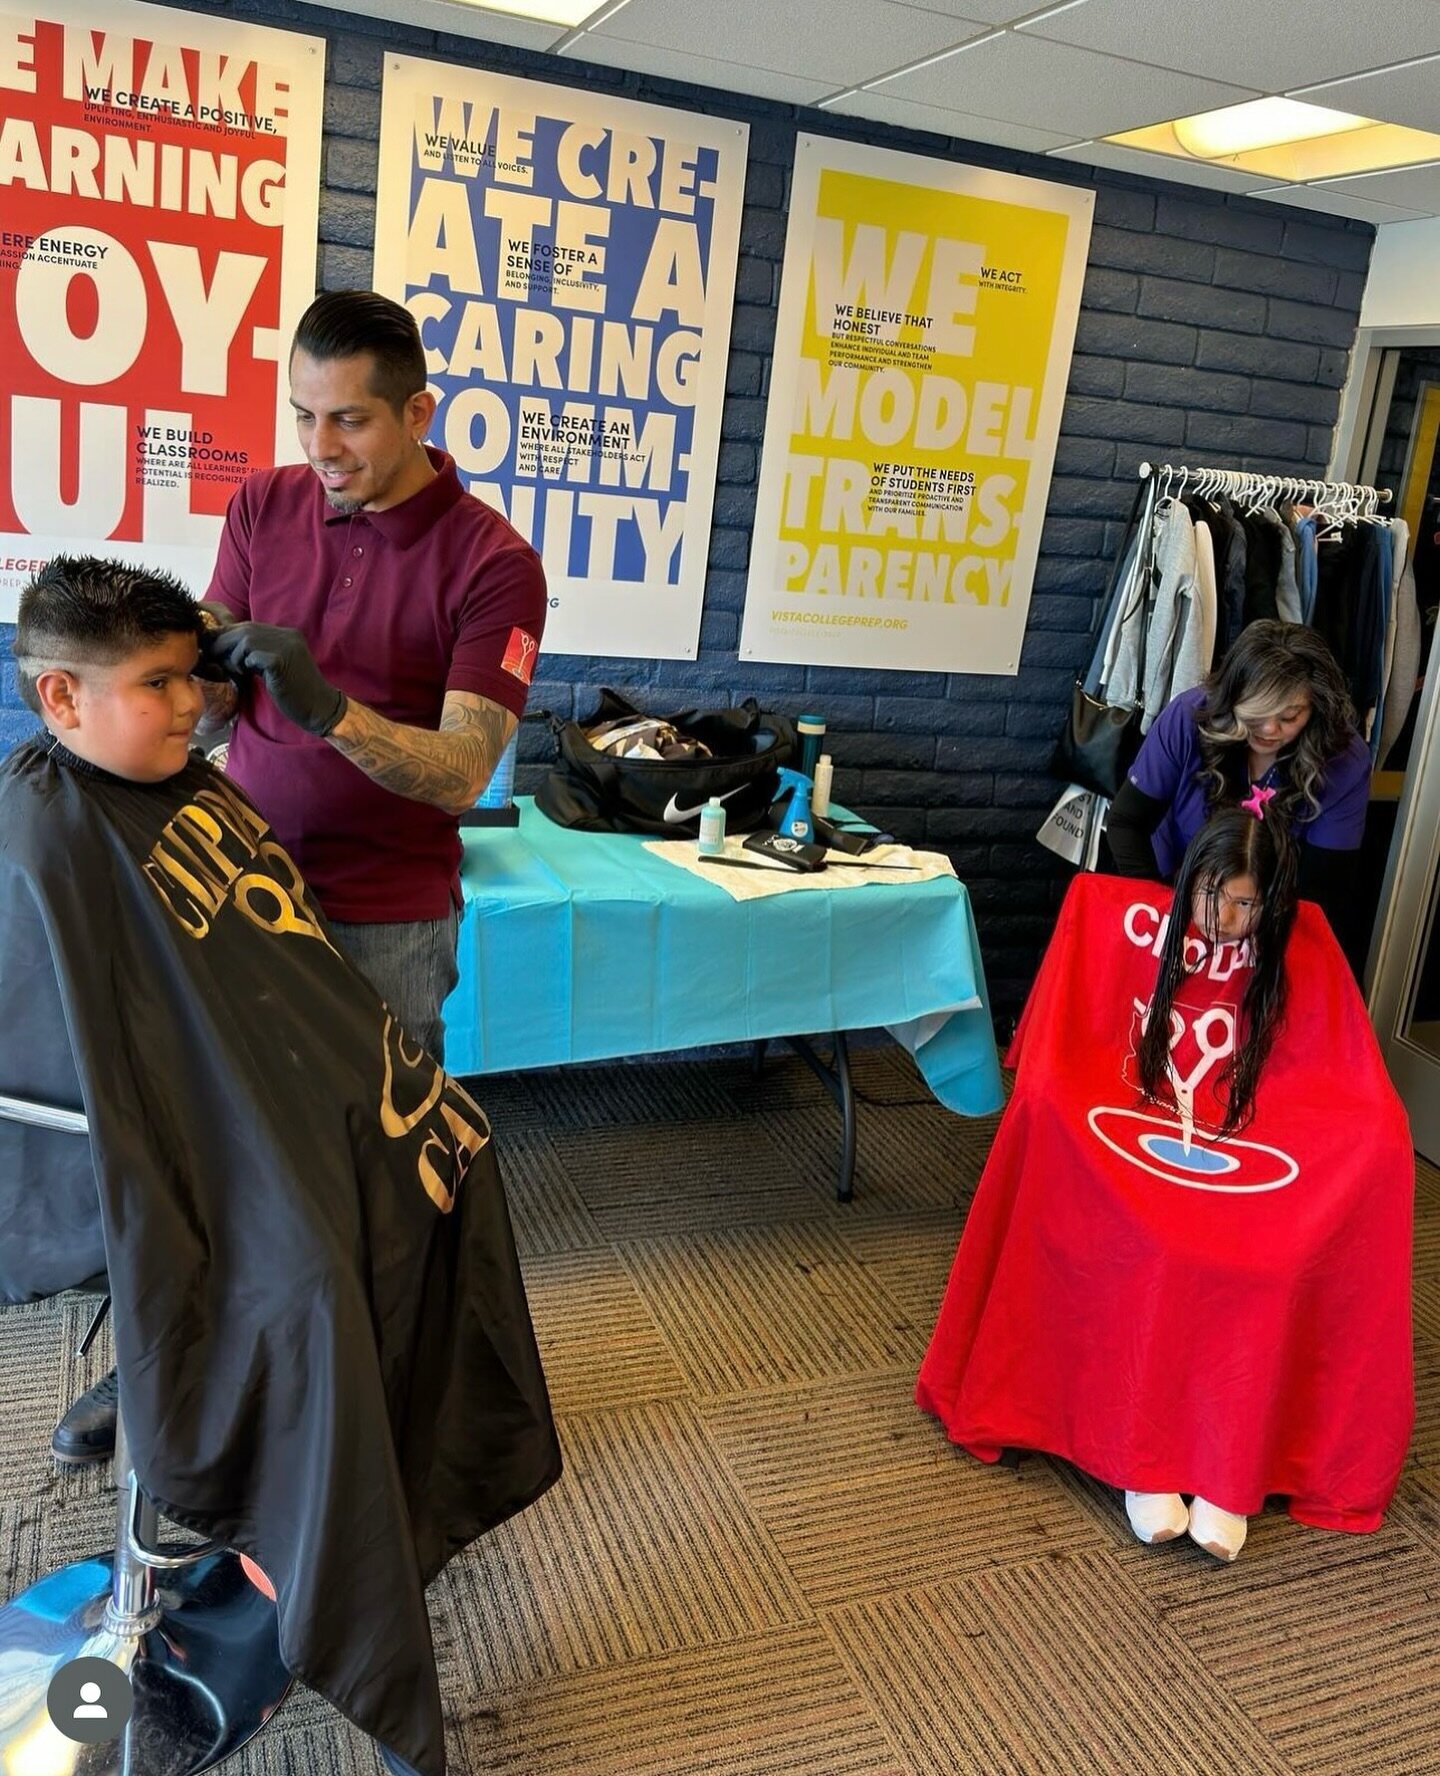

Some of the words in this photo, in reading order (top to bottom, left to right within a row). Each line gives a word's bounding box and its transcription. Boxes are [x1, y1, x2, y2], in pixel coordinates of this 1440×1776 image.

[63, 24, 290, 138] MAKE
[84, 85, 111, 102] WE
[116, 91, 181, 115] CREATE
[184, 104, 196, 117] A
[200, 105, 278, 134] POSITIVE,
[83, 102, 135, 120] UPLIFTING,
[136, 111, 202, 130] ENTHUSIASTIC
[203, 121, 222, 133] AND
[223, 125, 256, 139] JOYFUL
[413, 91, 537, 188] WE
[425, 132, 448, 149] WE
[450, 138, 497, 157] VALUE
[424, 149, 441, 158] AND
[443, 152, 470, 163] LISTEN
[470, 157, 482, 166] TO
[482, 159, 497, 169] ALL
[497, 162, 529, 174] VOICES.
[2, 232, 35, 249] ERE
[39, 237, 109, 259] ENERGY
[405, 176, 612, 314] ATE
[630, 216, 704, 329] A
[508, 239, 530, 254] WE
[533, 243, 586, 263] FOSTER
[587, 252, 598, 265] A
[37, 254, 98, 269] ACCENTUATE
[506, 255, 551, 273] SENSE
[553, 263, 574, 276] OF
[504, 280, 522, 289] AND
[978, 280, 994, 289] WITH
[980, 266, 998, 280] WE
[998, 270, 1023, 284] ACT
[812, 216, 987, 358] WE
[835, 303, 854, 317] WE
[856, 307, 902, 324] BELIEVE
[904, 314, 934, 329] THAT
[833, 318, 881, 336] HONEST
[404, 291, 703, 407] CARING
[830, 341, 861, 353] ENHANCE
[861, 344, 896, 357] INDIVIDUAL
[896, 350, 912, 359] AND
[912, 352, 930, 361] TEAM
[831, 332, 845, 340] BUT
[845, 334, 884, 346] RESPECTFUL
[884, 339, 937, 353] CONVERSATIONS
[828, 359, 843, 367] OUR
[829, 350, 877, 364] PERFORMANCE
[877, 356, 893, 365] AND
[892, 359, 933, 371] STRENGTHEN
[791, 357, 1036, 460] MODEL
[522, 410, 546, 426] WE
[549, 414, 607, 433] CREATE
[609, 421, 631, 436] AN
[136, 425, 161, 440] WE
[166, 428, 213, 445] BUILD
[521, 425, 631, 450] ENVIRONMENT
[136, 441, 248, 464] CLASSROOMS
[519, 441, 549, 452] WHERE
[551, 445, 566, 454] ALL
[566, 446, 629, 461] STAKEHOLDERS
[629, 454, 647, 463] ACT
[519, 452, 540, 462] WITH
[543, 455, 579, 466] RESPECT
[135, 456, 167, 467] WHERE
[168, 459, 185, 469] ARE
[186, 461, 203, 470] ALL
[135, 467, 183, 479] POTENTIAL
[184, 471, 193, 479] IS
[518, 463, 537, 472] AND
[873, 462, 891, 475] WE
[892, 464, 915, 476] PUT
[915, 466, 937, 479] THE
[939, 469, 975, 483] NEEDS
[135, 477, 180, 489] REALIZED.
[870, 475, 887, 487] OF
[888, 477, 945, 493] STUDENTS
[946, 483, 977, 497] FIRST
[868, 496, 911, 507] TRANSPARENT
[911, 500, 964, 512] COMMUNICATION
[869, 488, 882, 496] AND
[883, 489, 917, 499] PRIORITIZE
[917, 492, 951, 503] PROACTIVE
[950, 496, 965, 504] AND
[867, 505, 883, 513] WITH
[883, 506, 898, 514] OUR
[774, 539, 1017, 607] PARENCY
[770, 609, 909, 631] VISTACOLLEGEPREP.ORG
